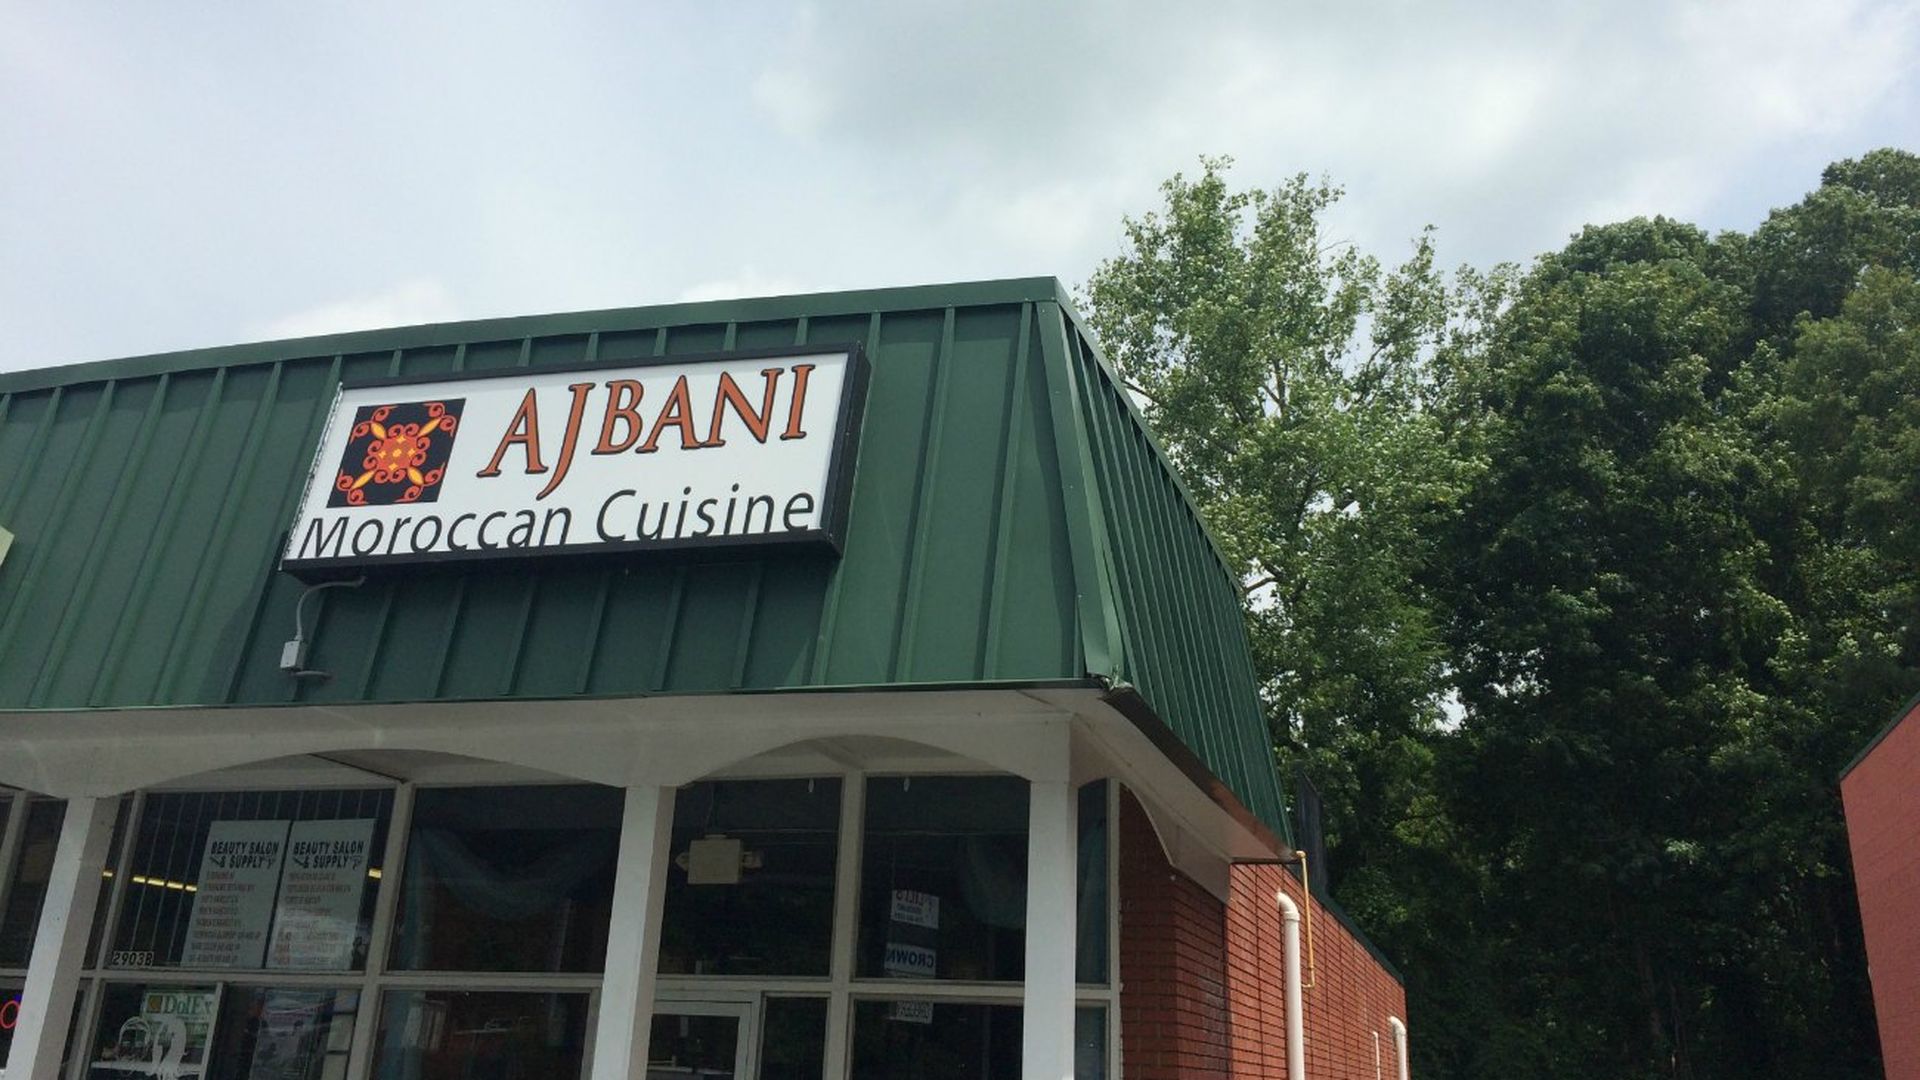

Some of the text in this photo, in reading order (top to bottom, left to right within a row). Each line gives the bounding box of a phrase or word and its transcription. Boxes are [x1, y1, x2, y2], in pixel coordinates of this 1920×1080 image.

[477, 364, 816, 500] AJBANI
[299, 483, 815, 559] Moroccan Cuisine
[211, 840, 280, 855] BEAUTY SALON
[294, 840, 365, 855] BEAUTY SALON
[230, 855, 263, 868] SUPPLY
[313, 855, 348, 868] SUPPLY
[112, 952, 153, 966] 2903B
